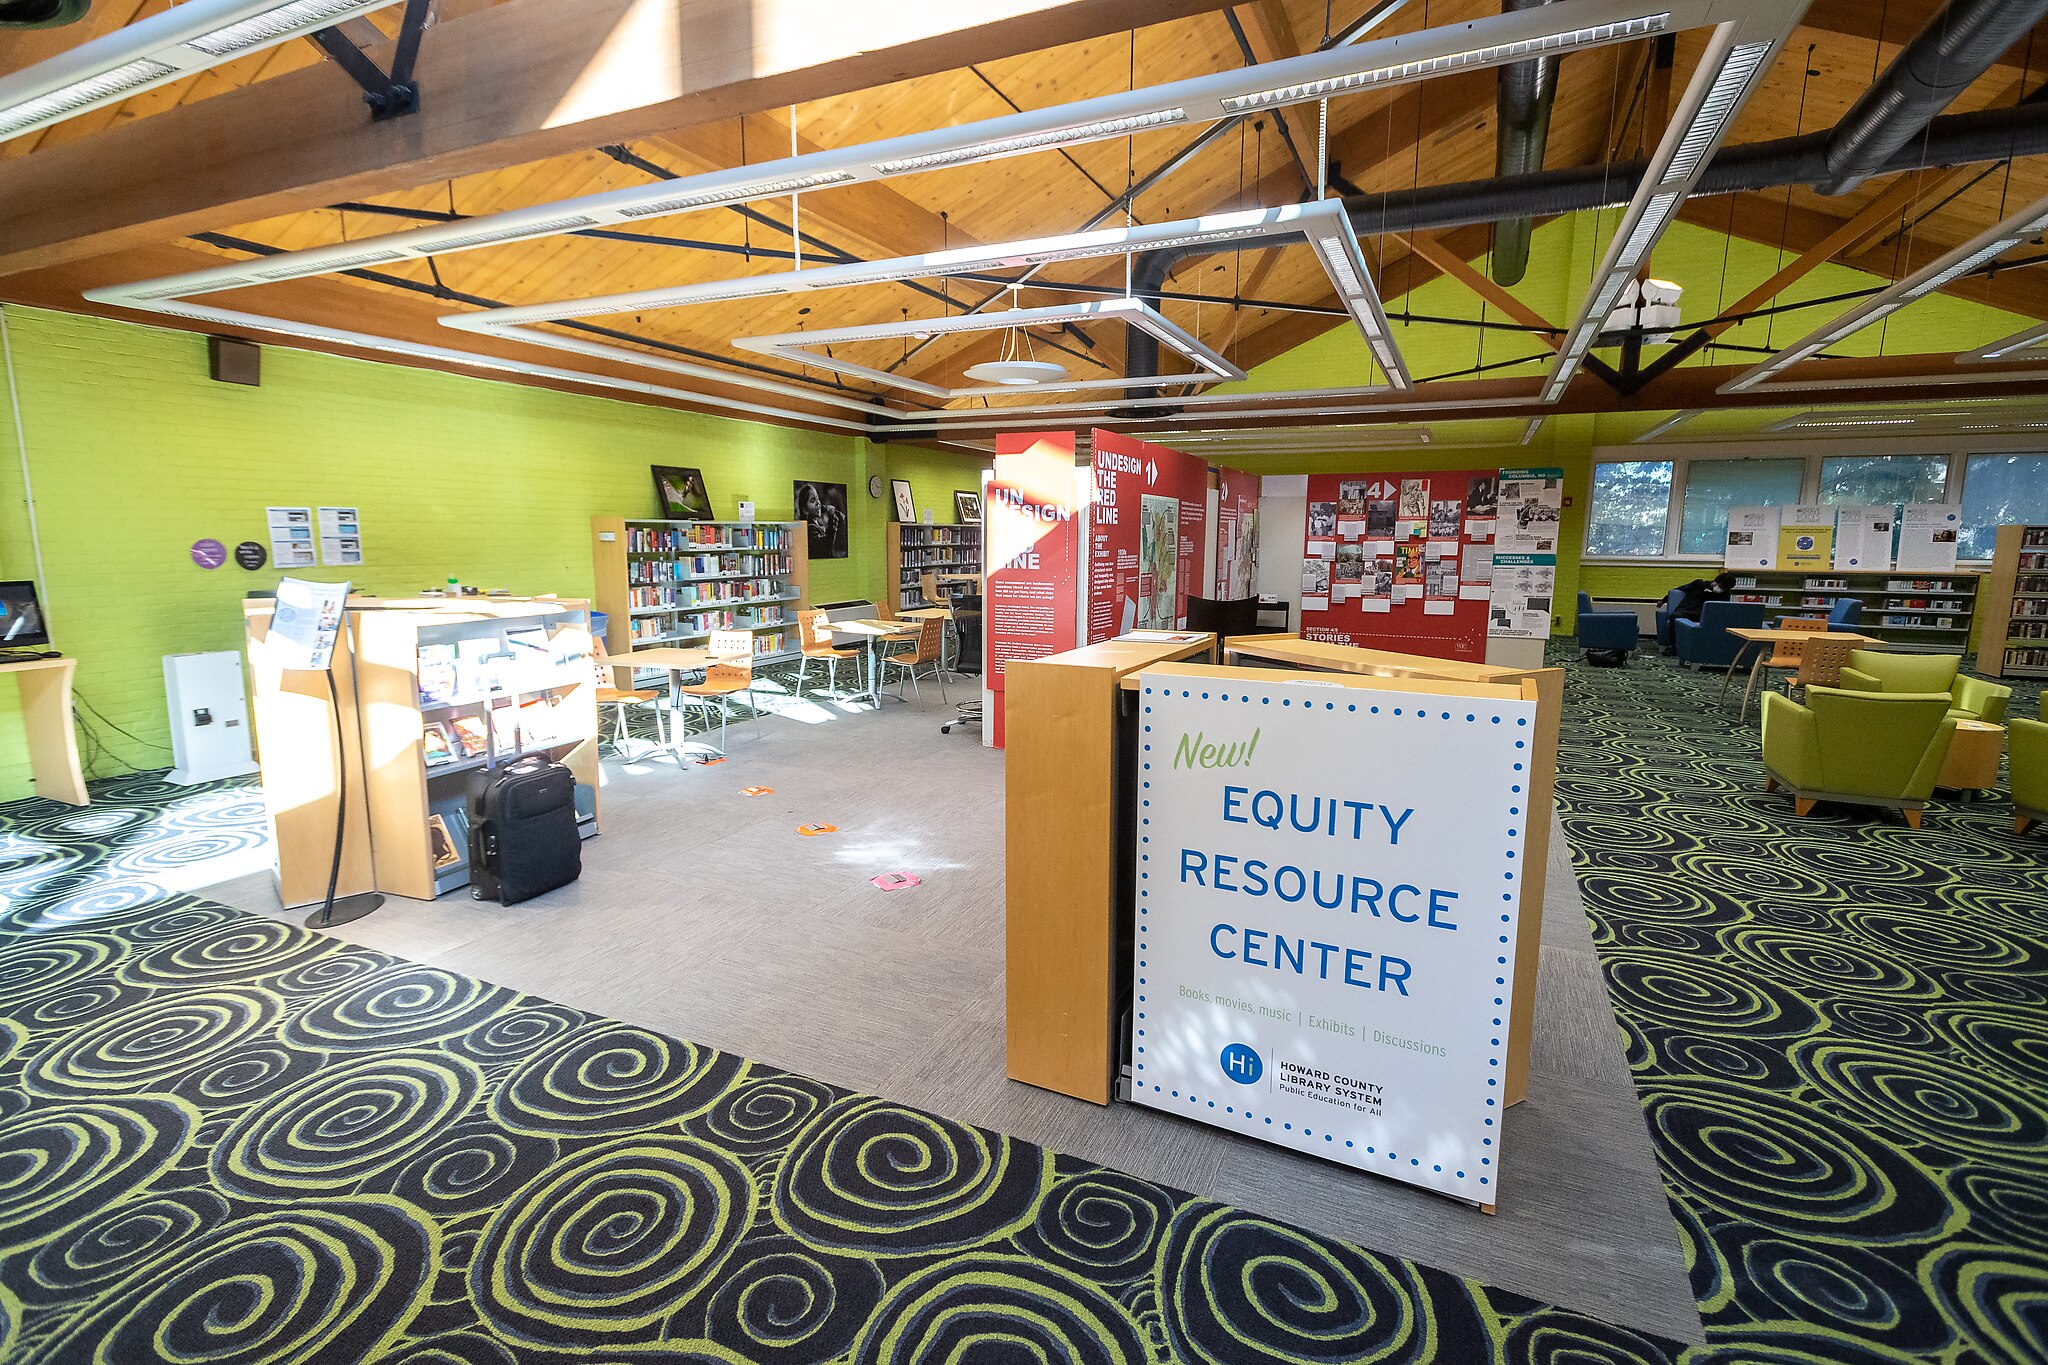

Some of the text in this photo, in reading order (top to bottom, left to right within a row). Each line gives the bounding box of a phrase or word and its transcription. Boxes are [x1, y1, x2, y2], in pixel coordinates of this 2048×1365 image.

[1097, 450, 1142, 475] UNDESIGN
[1145, 461, 1151, 485] 1
[1096, 469, 1117, 489] THE
[1367, 482, 1381, 498] 4
[995, 488, 1024, 505] UN
[1097, 488, 1116, 506] RED
[1096, 506, 1119, 525] LINE
[1305, 633, 1351, 642] STORIES
[1173, 727, 1261, 770] New!
[1223, 785, 1415, 846] EQUITY
[1179, 848, 1460, 932] RESOURCE
[1209, 923, 1413, 998] CENTER
[1179, 985, 1447, 1058] Books, movies, music Exhibits Discussions
[1229, 1051, 1254, 1077] Hi
[1280, 1060, 1384, 1095] HOWARD COUNTY
[1280, 1072, 1382, 1107] LIBRARY SYSTEM
[1279, 1084, 1382, 1117] Public Education for All
